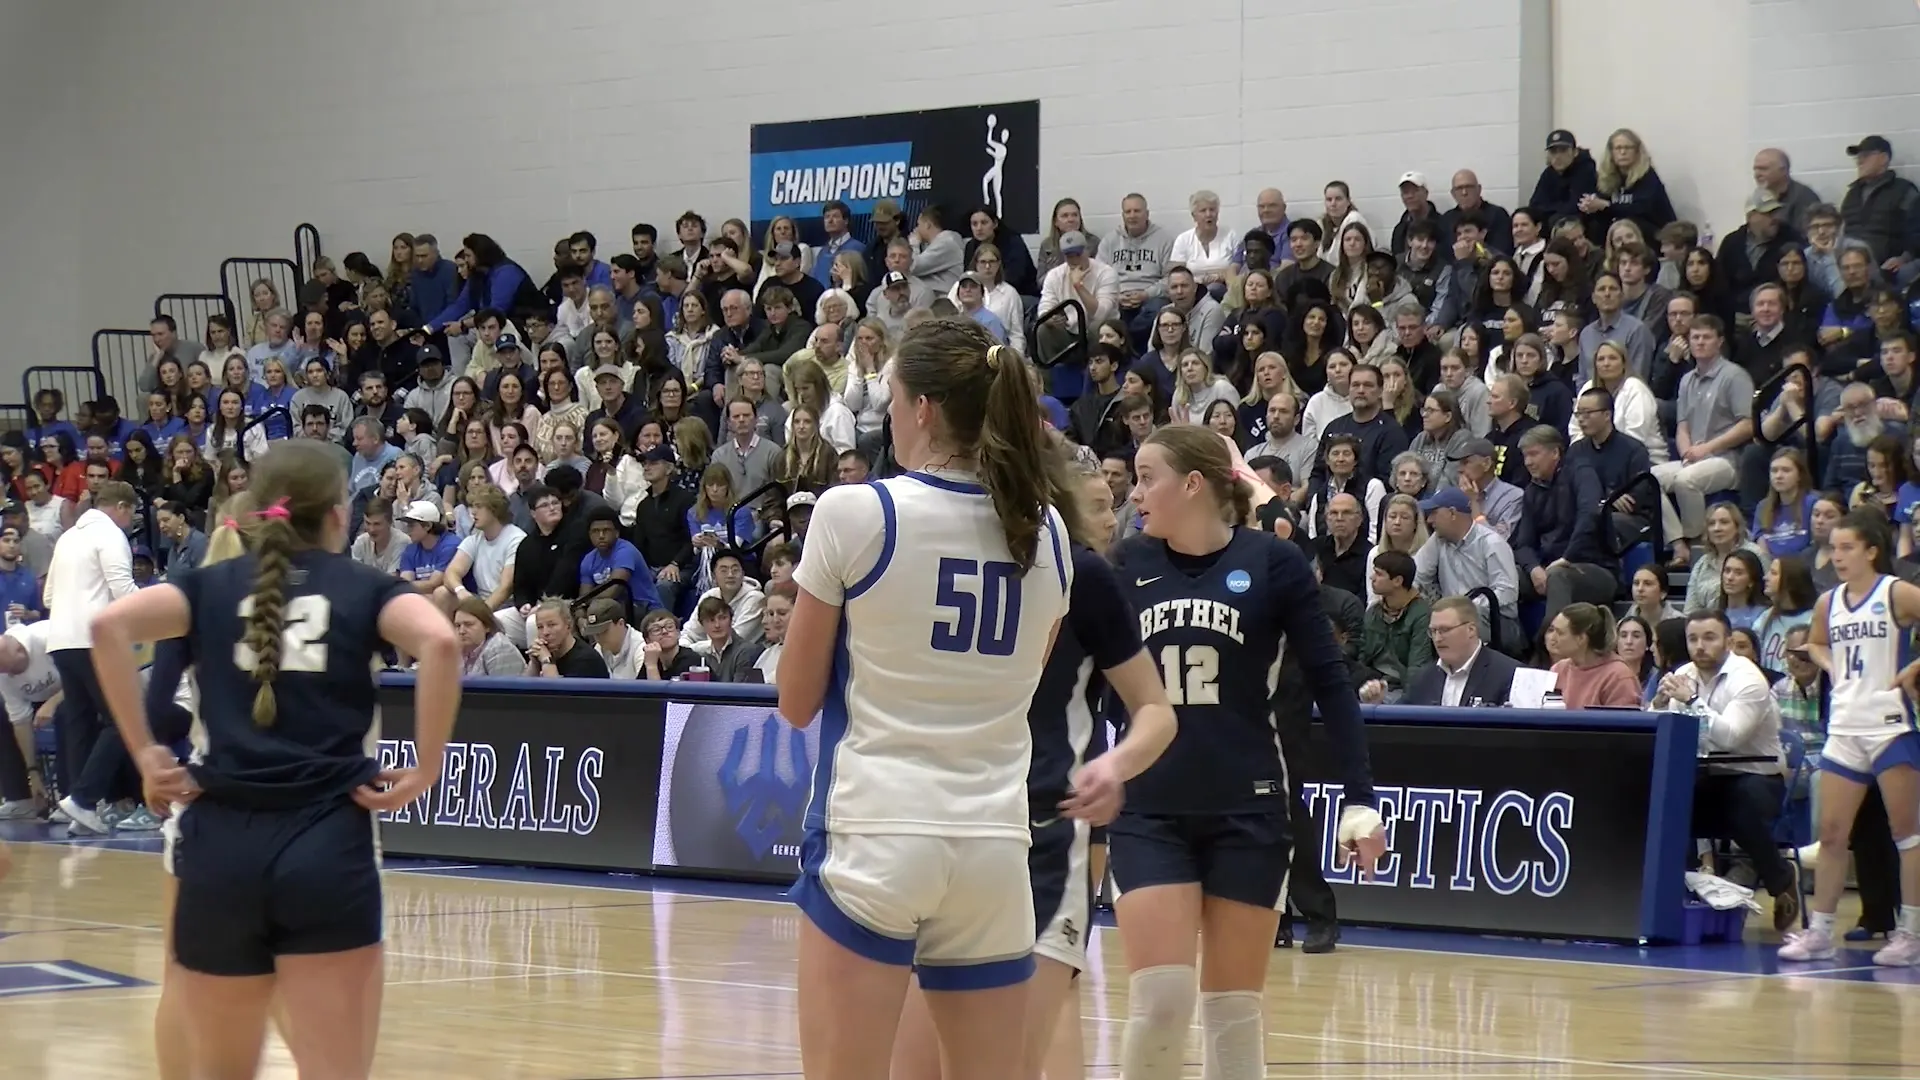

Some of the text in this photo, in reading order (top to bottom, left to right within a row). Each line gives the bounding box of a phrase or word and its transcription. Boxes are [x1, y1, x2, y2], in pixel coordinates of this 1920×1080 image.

[771, 162, 906, 205] CHAMPIONS
[908, 178, 932, 191] HERE
[911, 166, 931, 178] WIN
[931, 557, 1021, 656] 50
[1139, 599, 1244, 645] BETHEL
[1830, 620, 1887, 643] ENERALS
[1161, 645, 1220, 705] 12
[1845, 644, 1863, 680] 14
